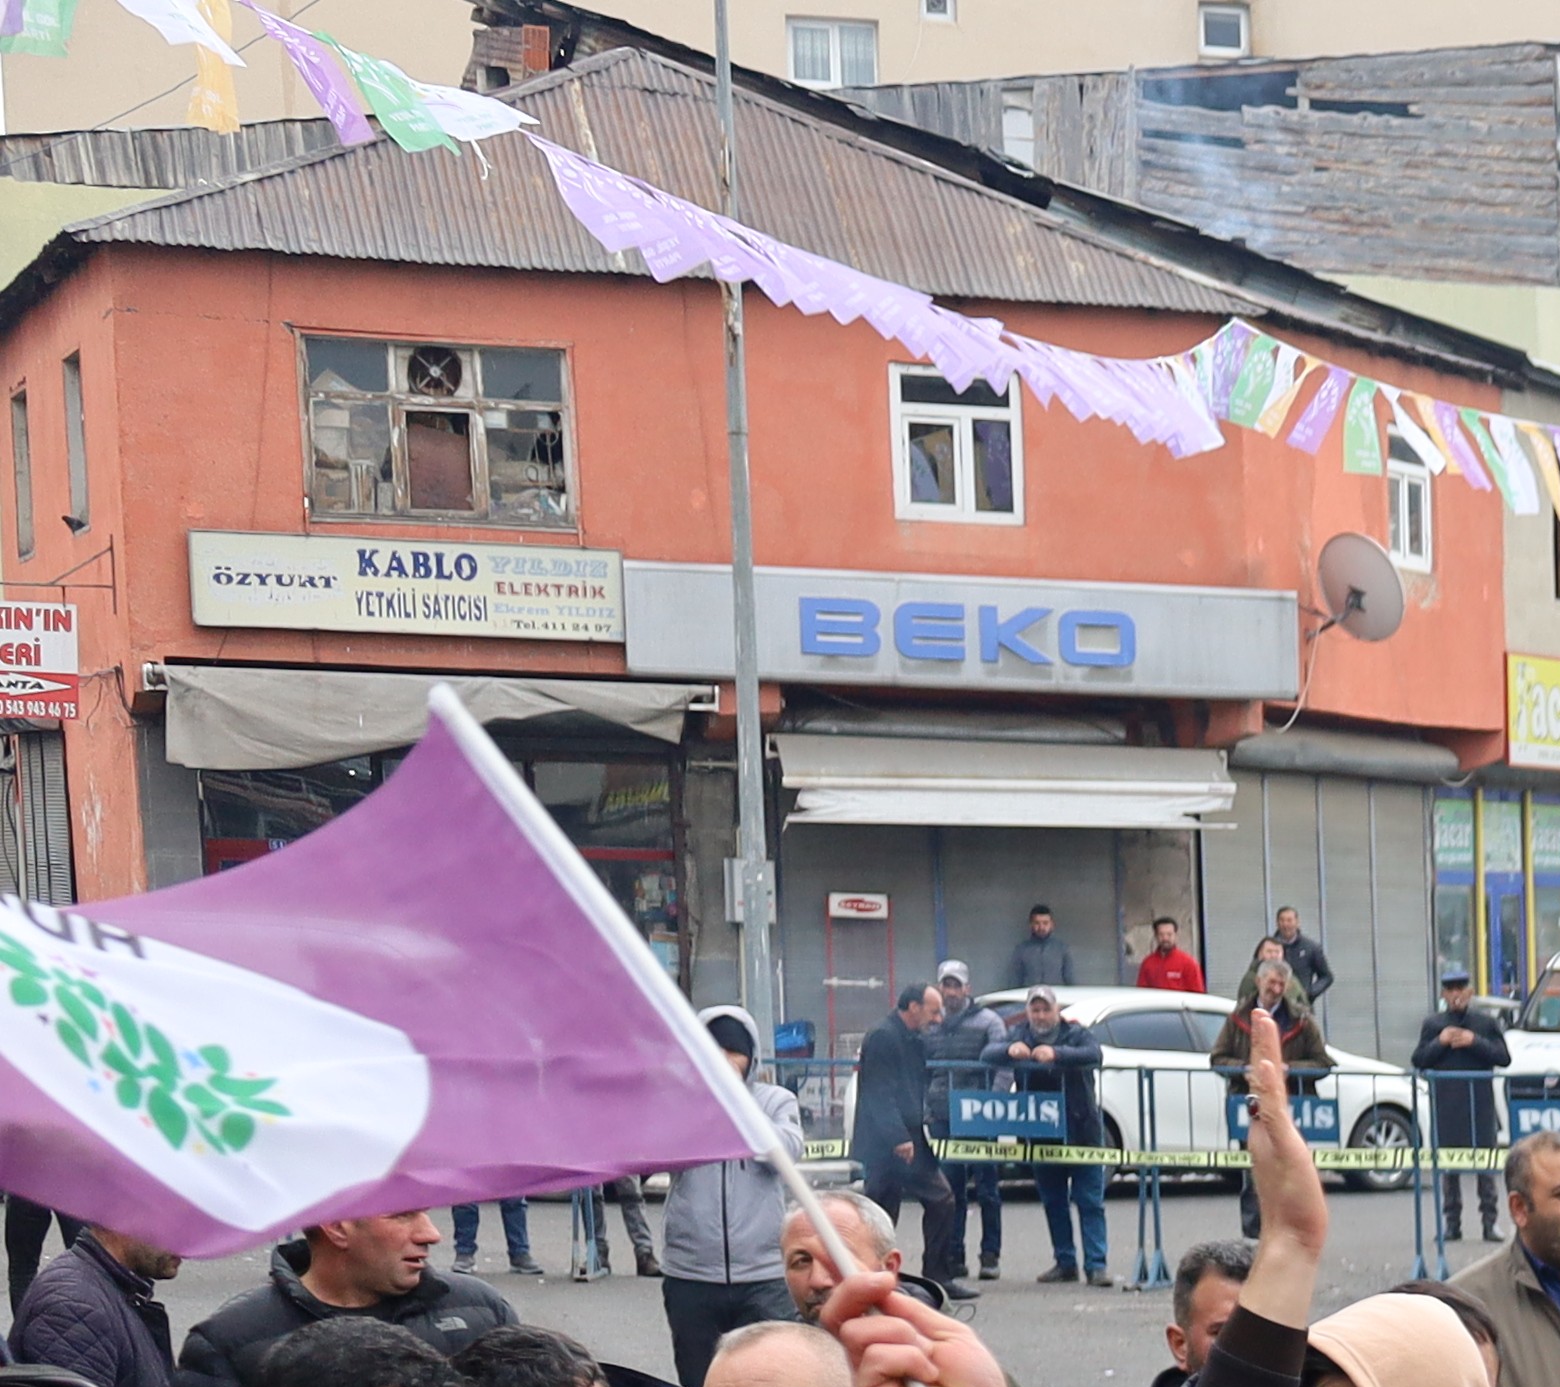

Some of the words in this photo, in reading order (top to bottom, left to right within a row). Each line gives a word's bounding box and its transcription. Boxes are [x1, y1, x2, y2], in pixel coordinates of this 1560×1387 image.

[212, 565, 339, 590] ÖZYURT
[356, 549, 479, 581] KABLO
[487, 554, 609, 580] YILDIZ
[493, 579, 607, 600] ELEKTRİK
[355, 586, 418, 621] YETKİLİ
[493, 602, 551, 617] Ekrem
[555, 605, 616, 620] YILDIZ
[0, 606, 72, 632] IN'IN
[800, 596, 1136, 668] BEKO
[0, 892, 147, 960] HD
[960, 1095, 1060, 1123] POLİS
